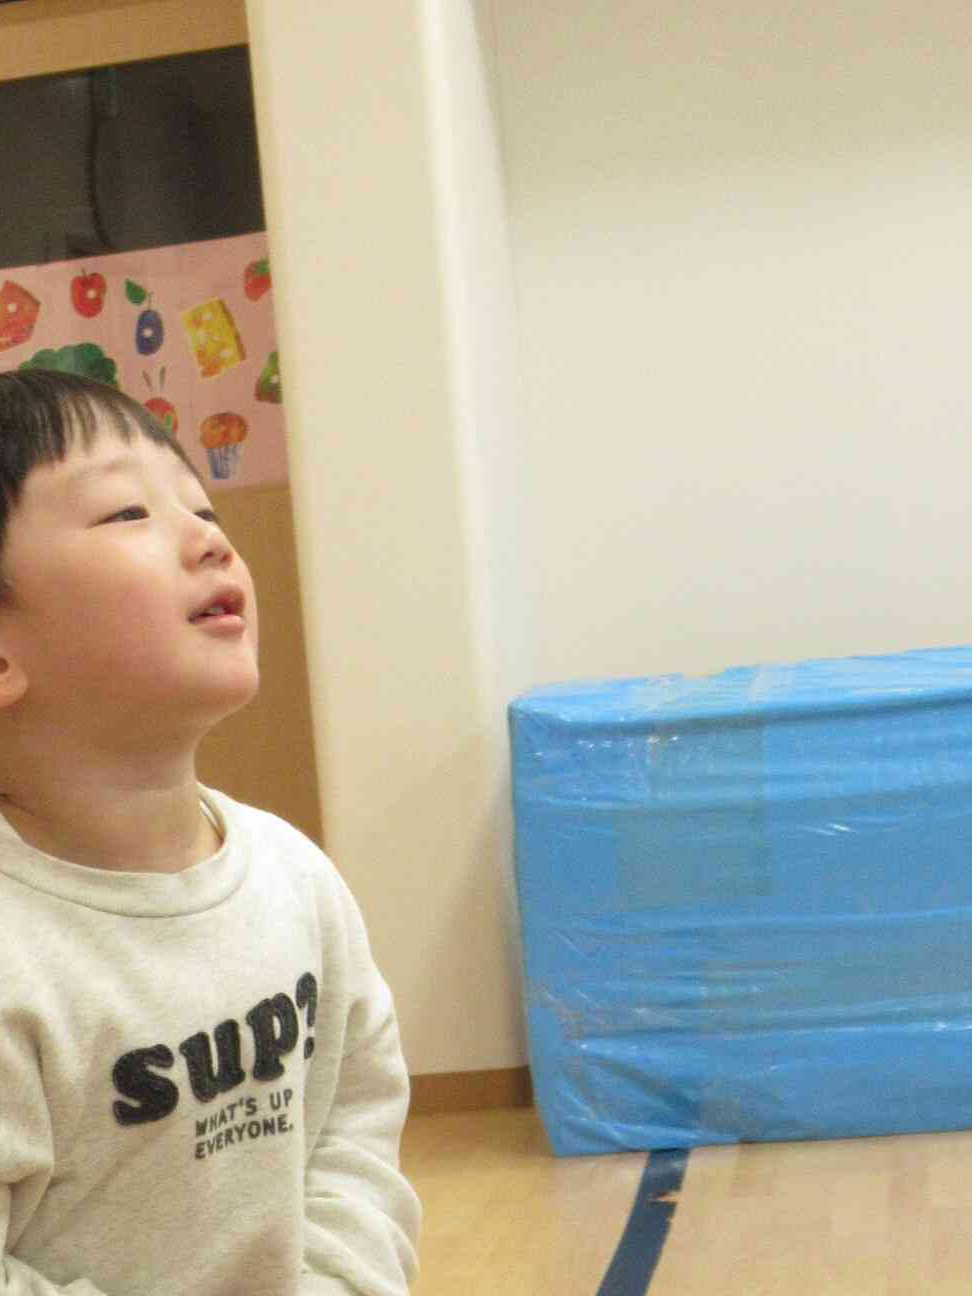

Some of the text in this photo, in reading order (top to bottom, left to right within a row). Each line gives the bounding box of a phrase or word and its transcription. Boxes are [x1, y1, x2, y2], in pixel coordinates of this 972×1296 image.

[194, 1087, 294, 1138] WHAT'S UP
[194, 1113, 295, 1160] EVERYONE.
